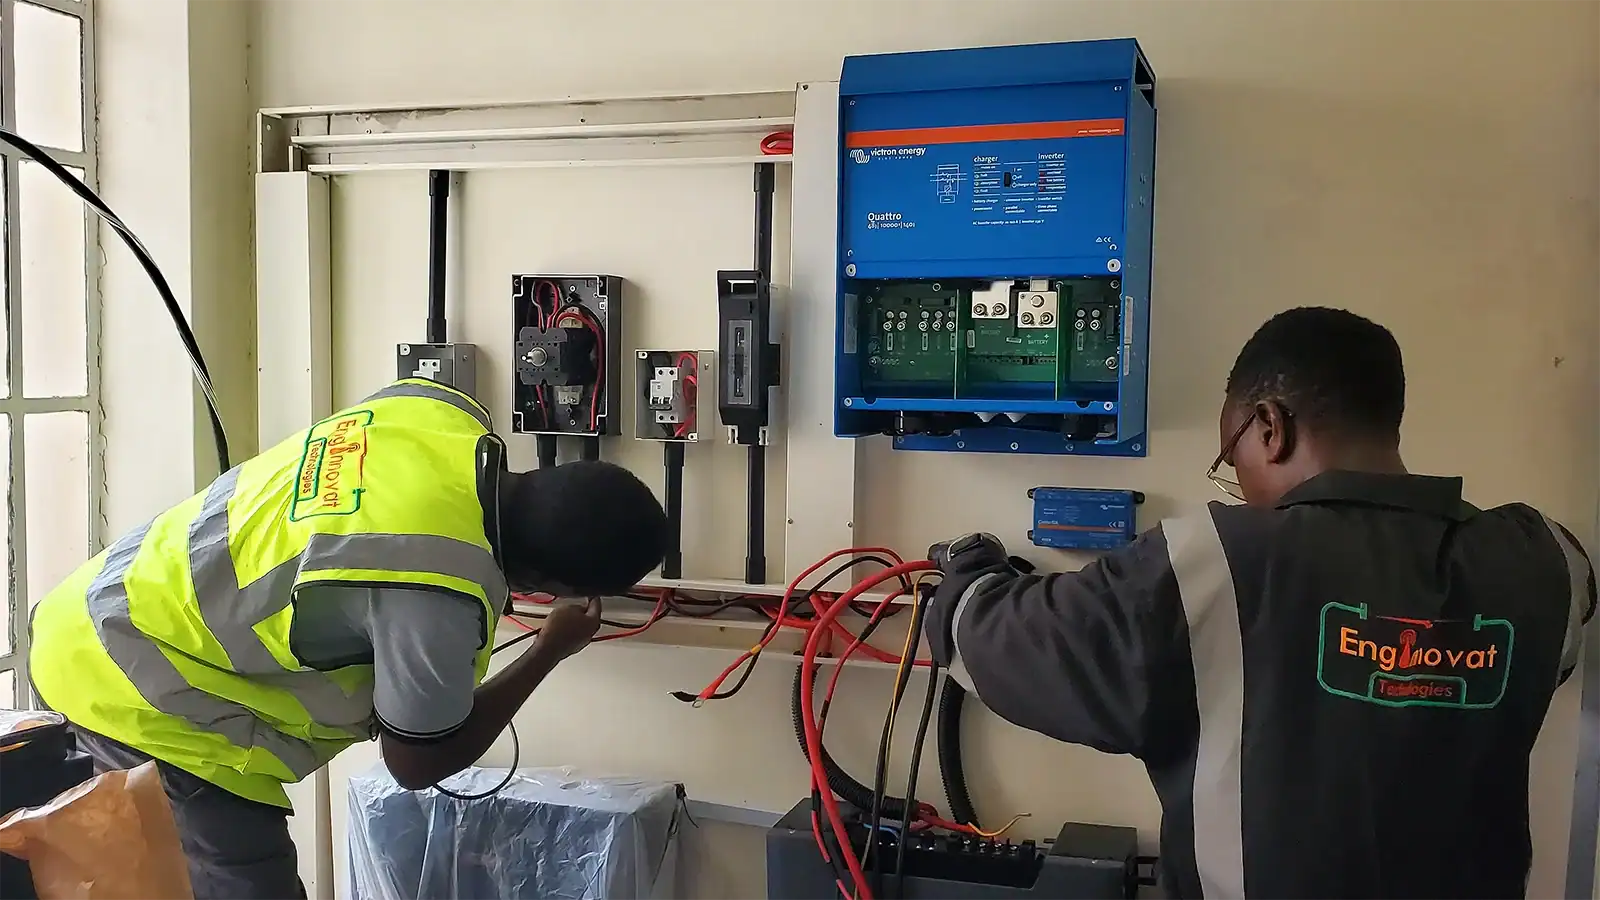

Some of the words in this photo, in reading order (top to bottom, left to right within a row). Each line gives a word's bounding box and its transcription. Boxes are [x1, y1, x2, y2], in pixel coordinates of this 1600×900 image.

[870, 147, 897, 156] victron
[898, 147, 926, 157] energy
[867, 212, 902, 221] Quattro
